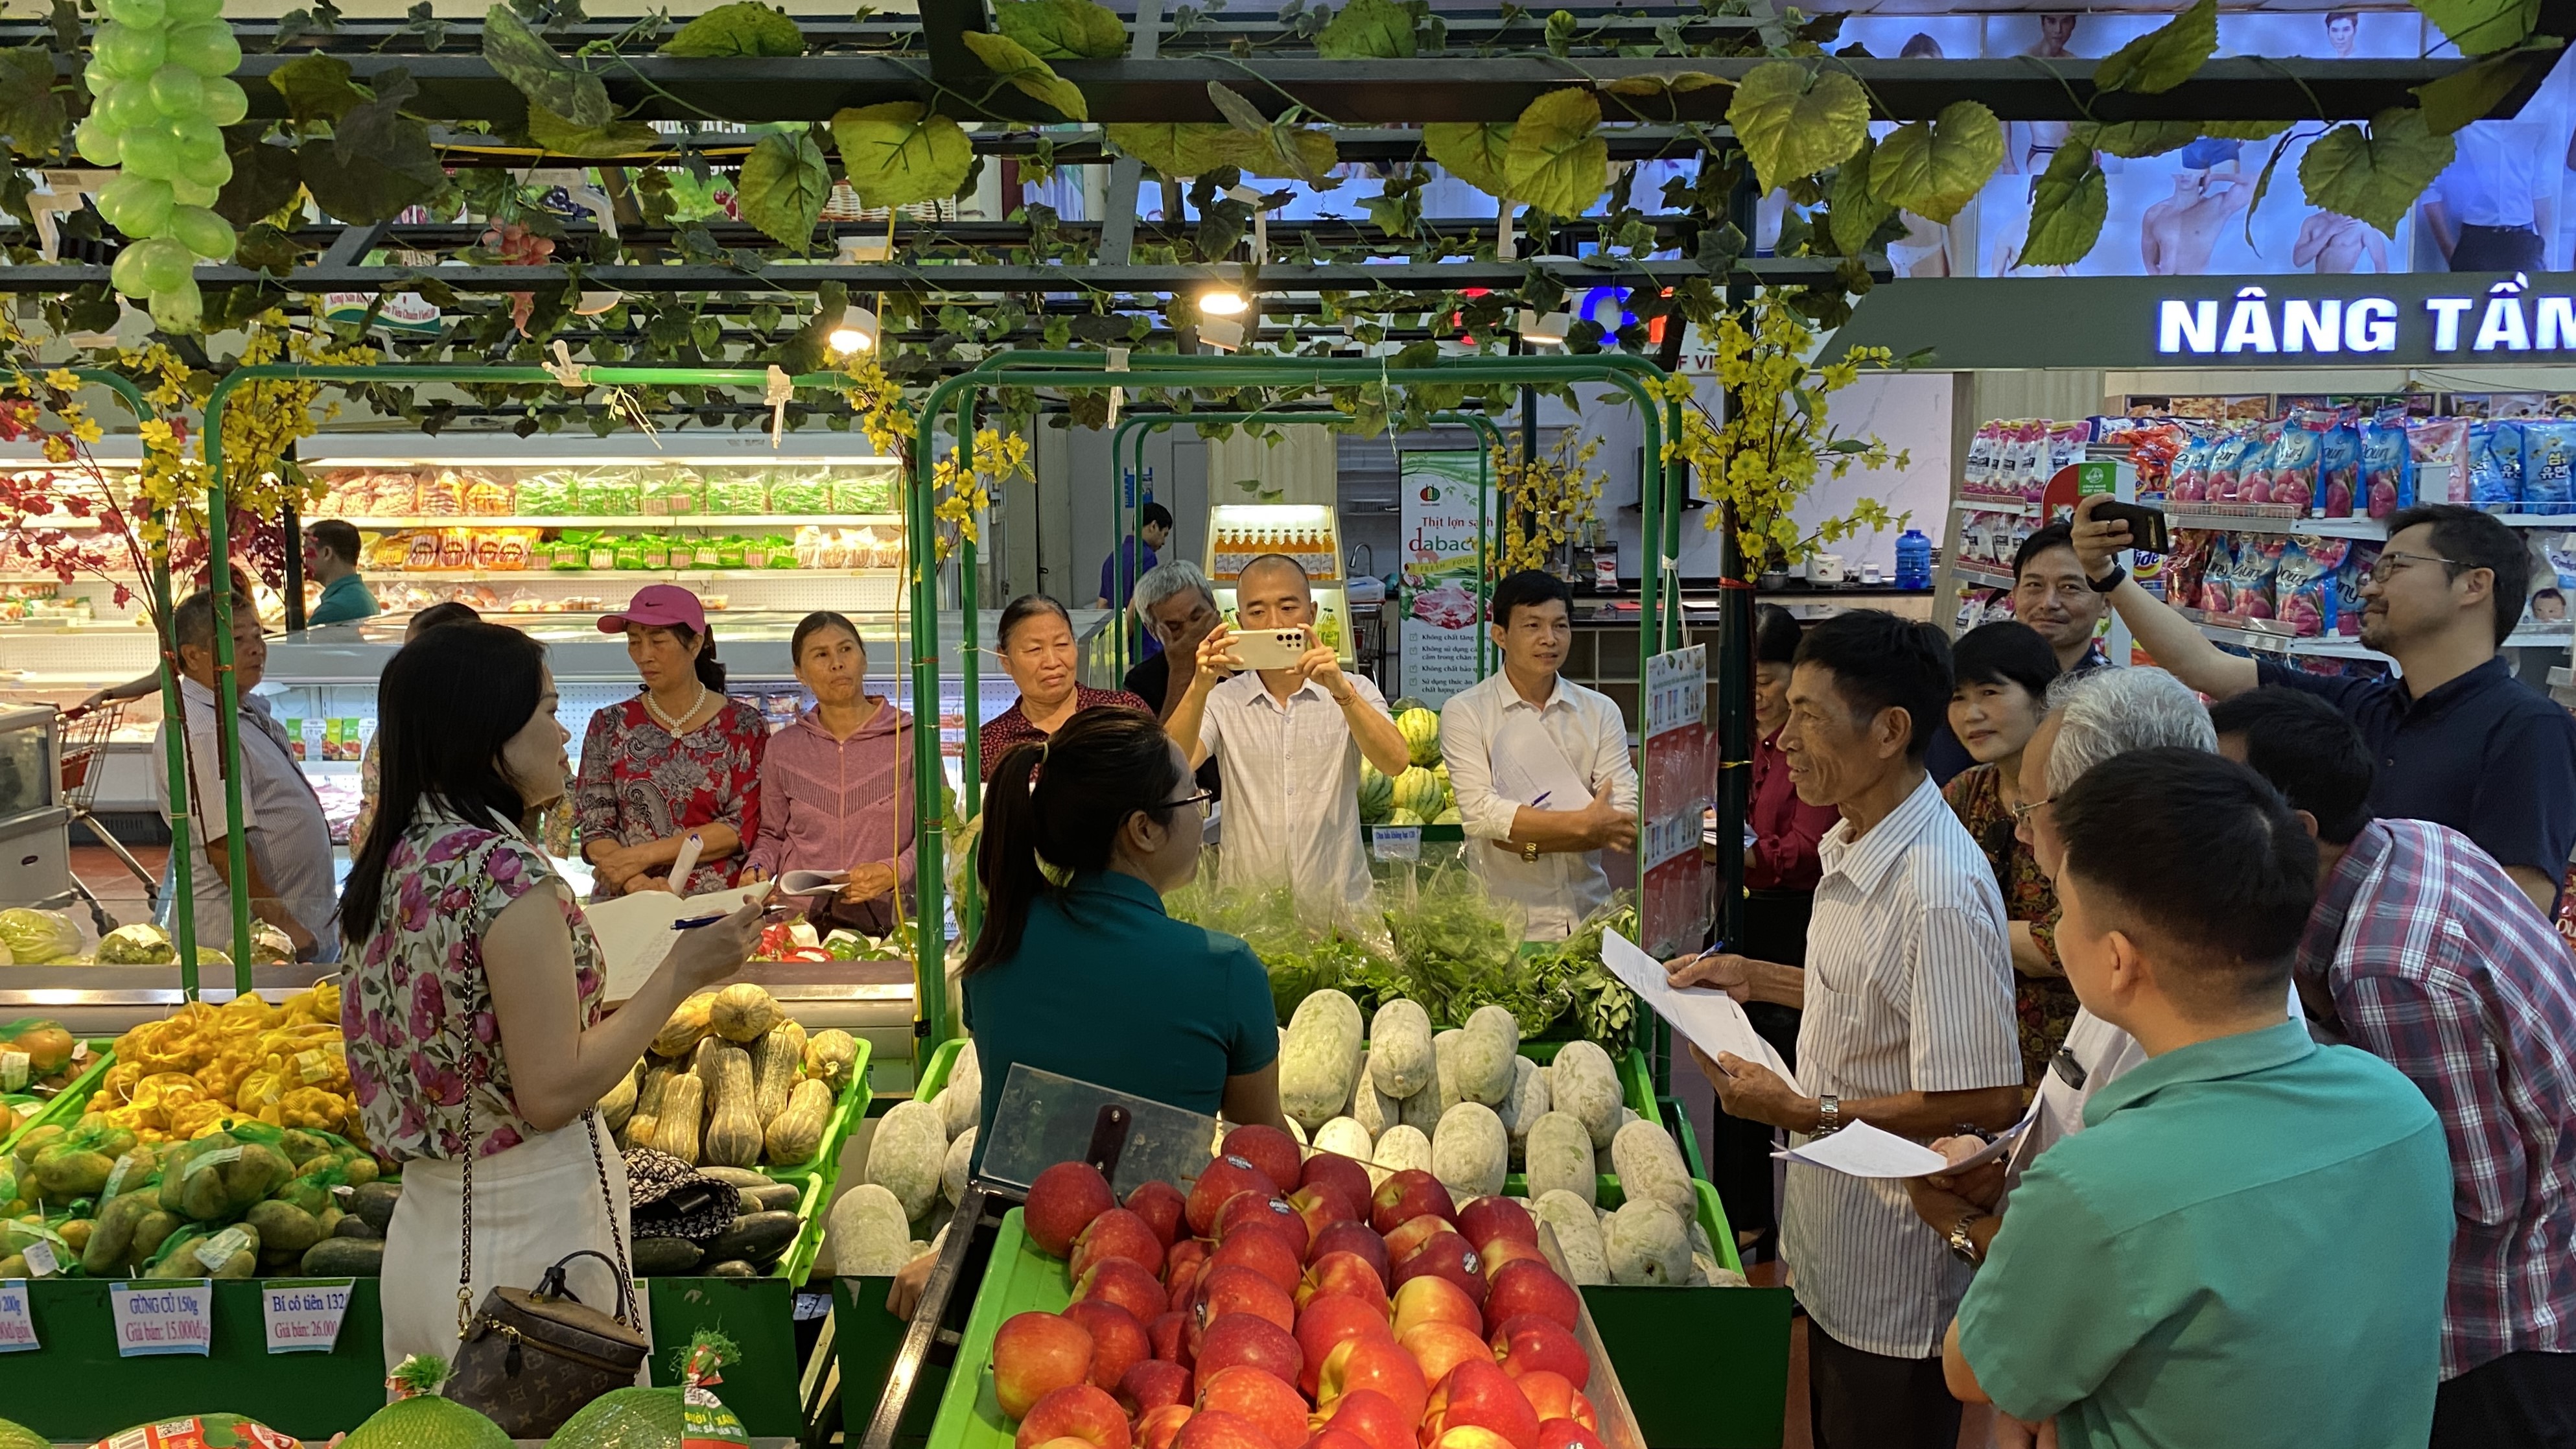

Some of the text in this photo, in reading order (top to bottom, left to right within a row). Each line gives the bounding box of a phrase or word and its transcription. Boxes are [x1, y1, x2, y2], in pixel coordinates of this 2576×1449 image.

[2159, 286, 2398, 352] NÂNG
[1422, 516, 1493, 530] Thịt lợn sạh
[1420, 557, 1475, 572] FRESH FOOD
[2134, 550, 2160, 567] ide
[1431, 678, 1447, 687] dụng
[130, 1292, 199, 1316] GỪNG CỦ 150g
[272, 1295, 287, 1312] Bí
[303, 1293, 324, 1310] tiên
[126, 1321, 144, 1342] Giá
[143, 1321, 163, 1341] bán:
[275, 1322, 291, 1339] Giá
[291, 1321, 310, 1337] bán:
